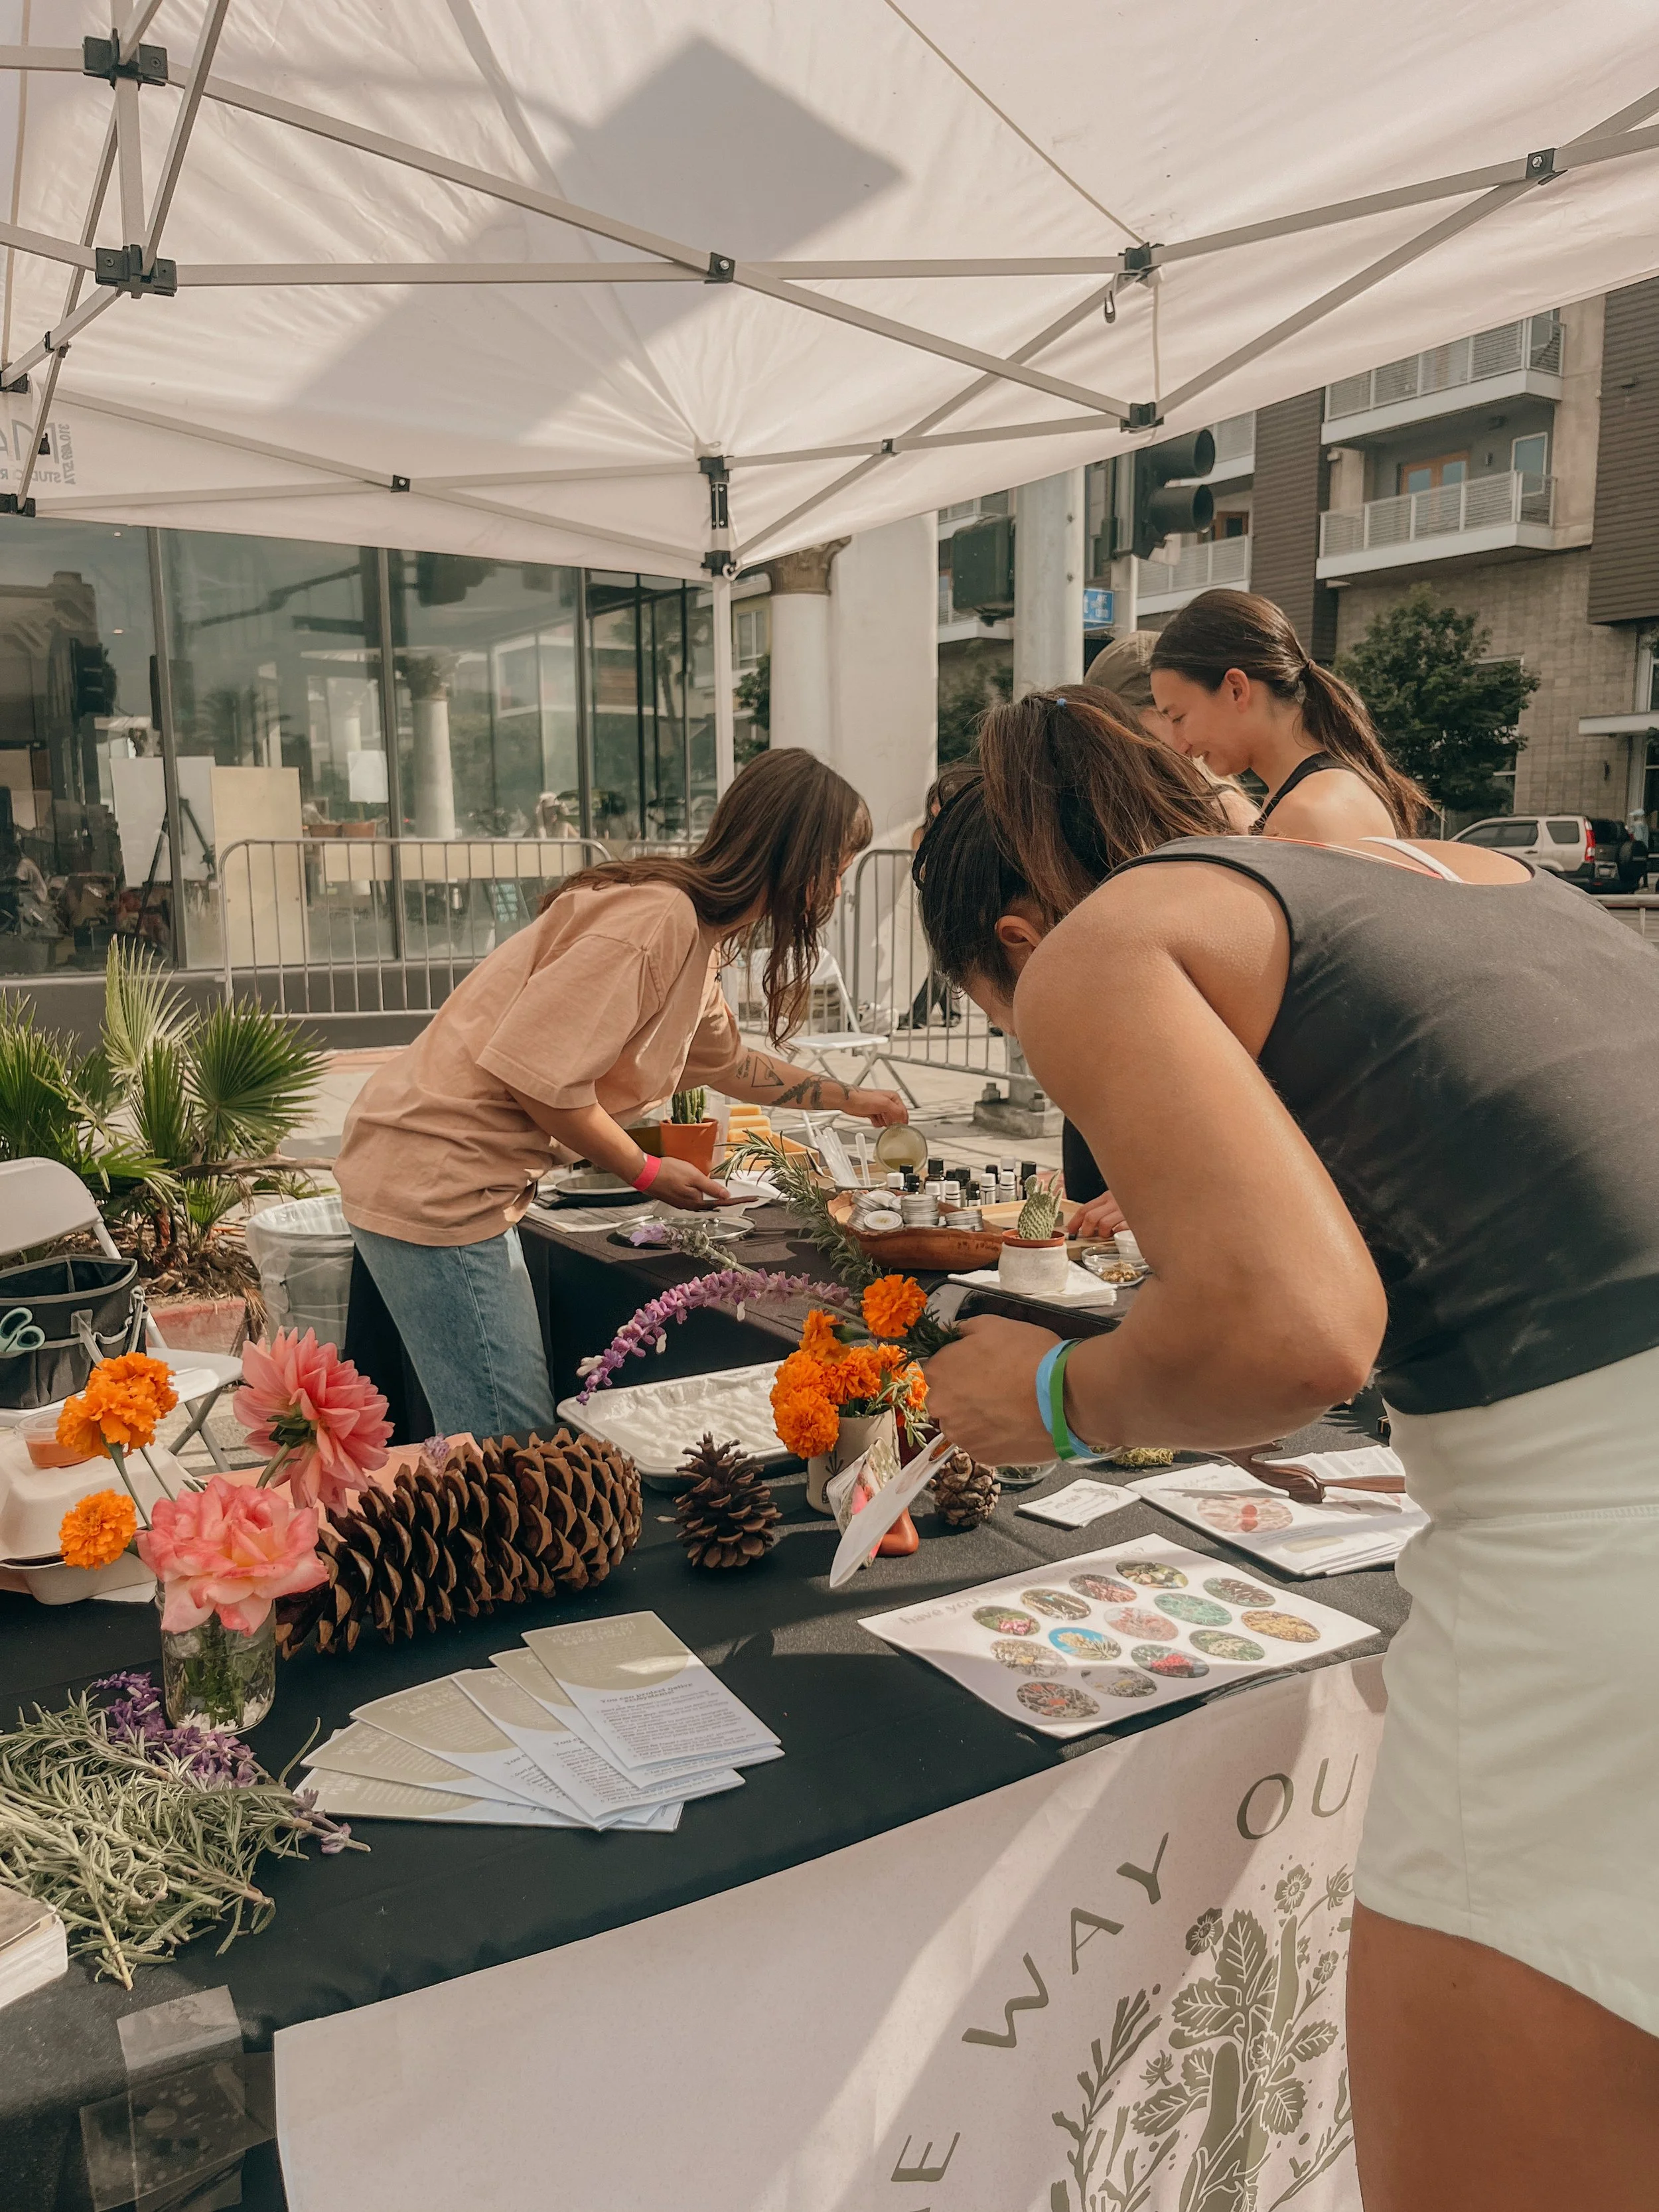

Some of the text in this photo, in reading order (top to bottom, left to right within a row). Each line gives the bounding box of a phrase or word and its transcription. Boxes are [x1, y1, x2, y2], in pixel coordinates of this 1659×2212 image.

[899, 1606, 945, 1626] have
[945, 1597, 979, 1615] you
[962, 1832, 1169, 2048] WAY
[1236, 1753, 1359, 1840] OU
